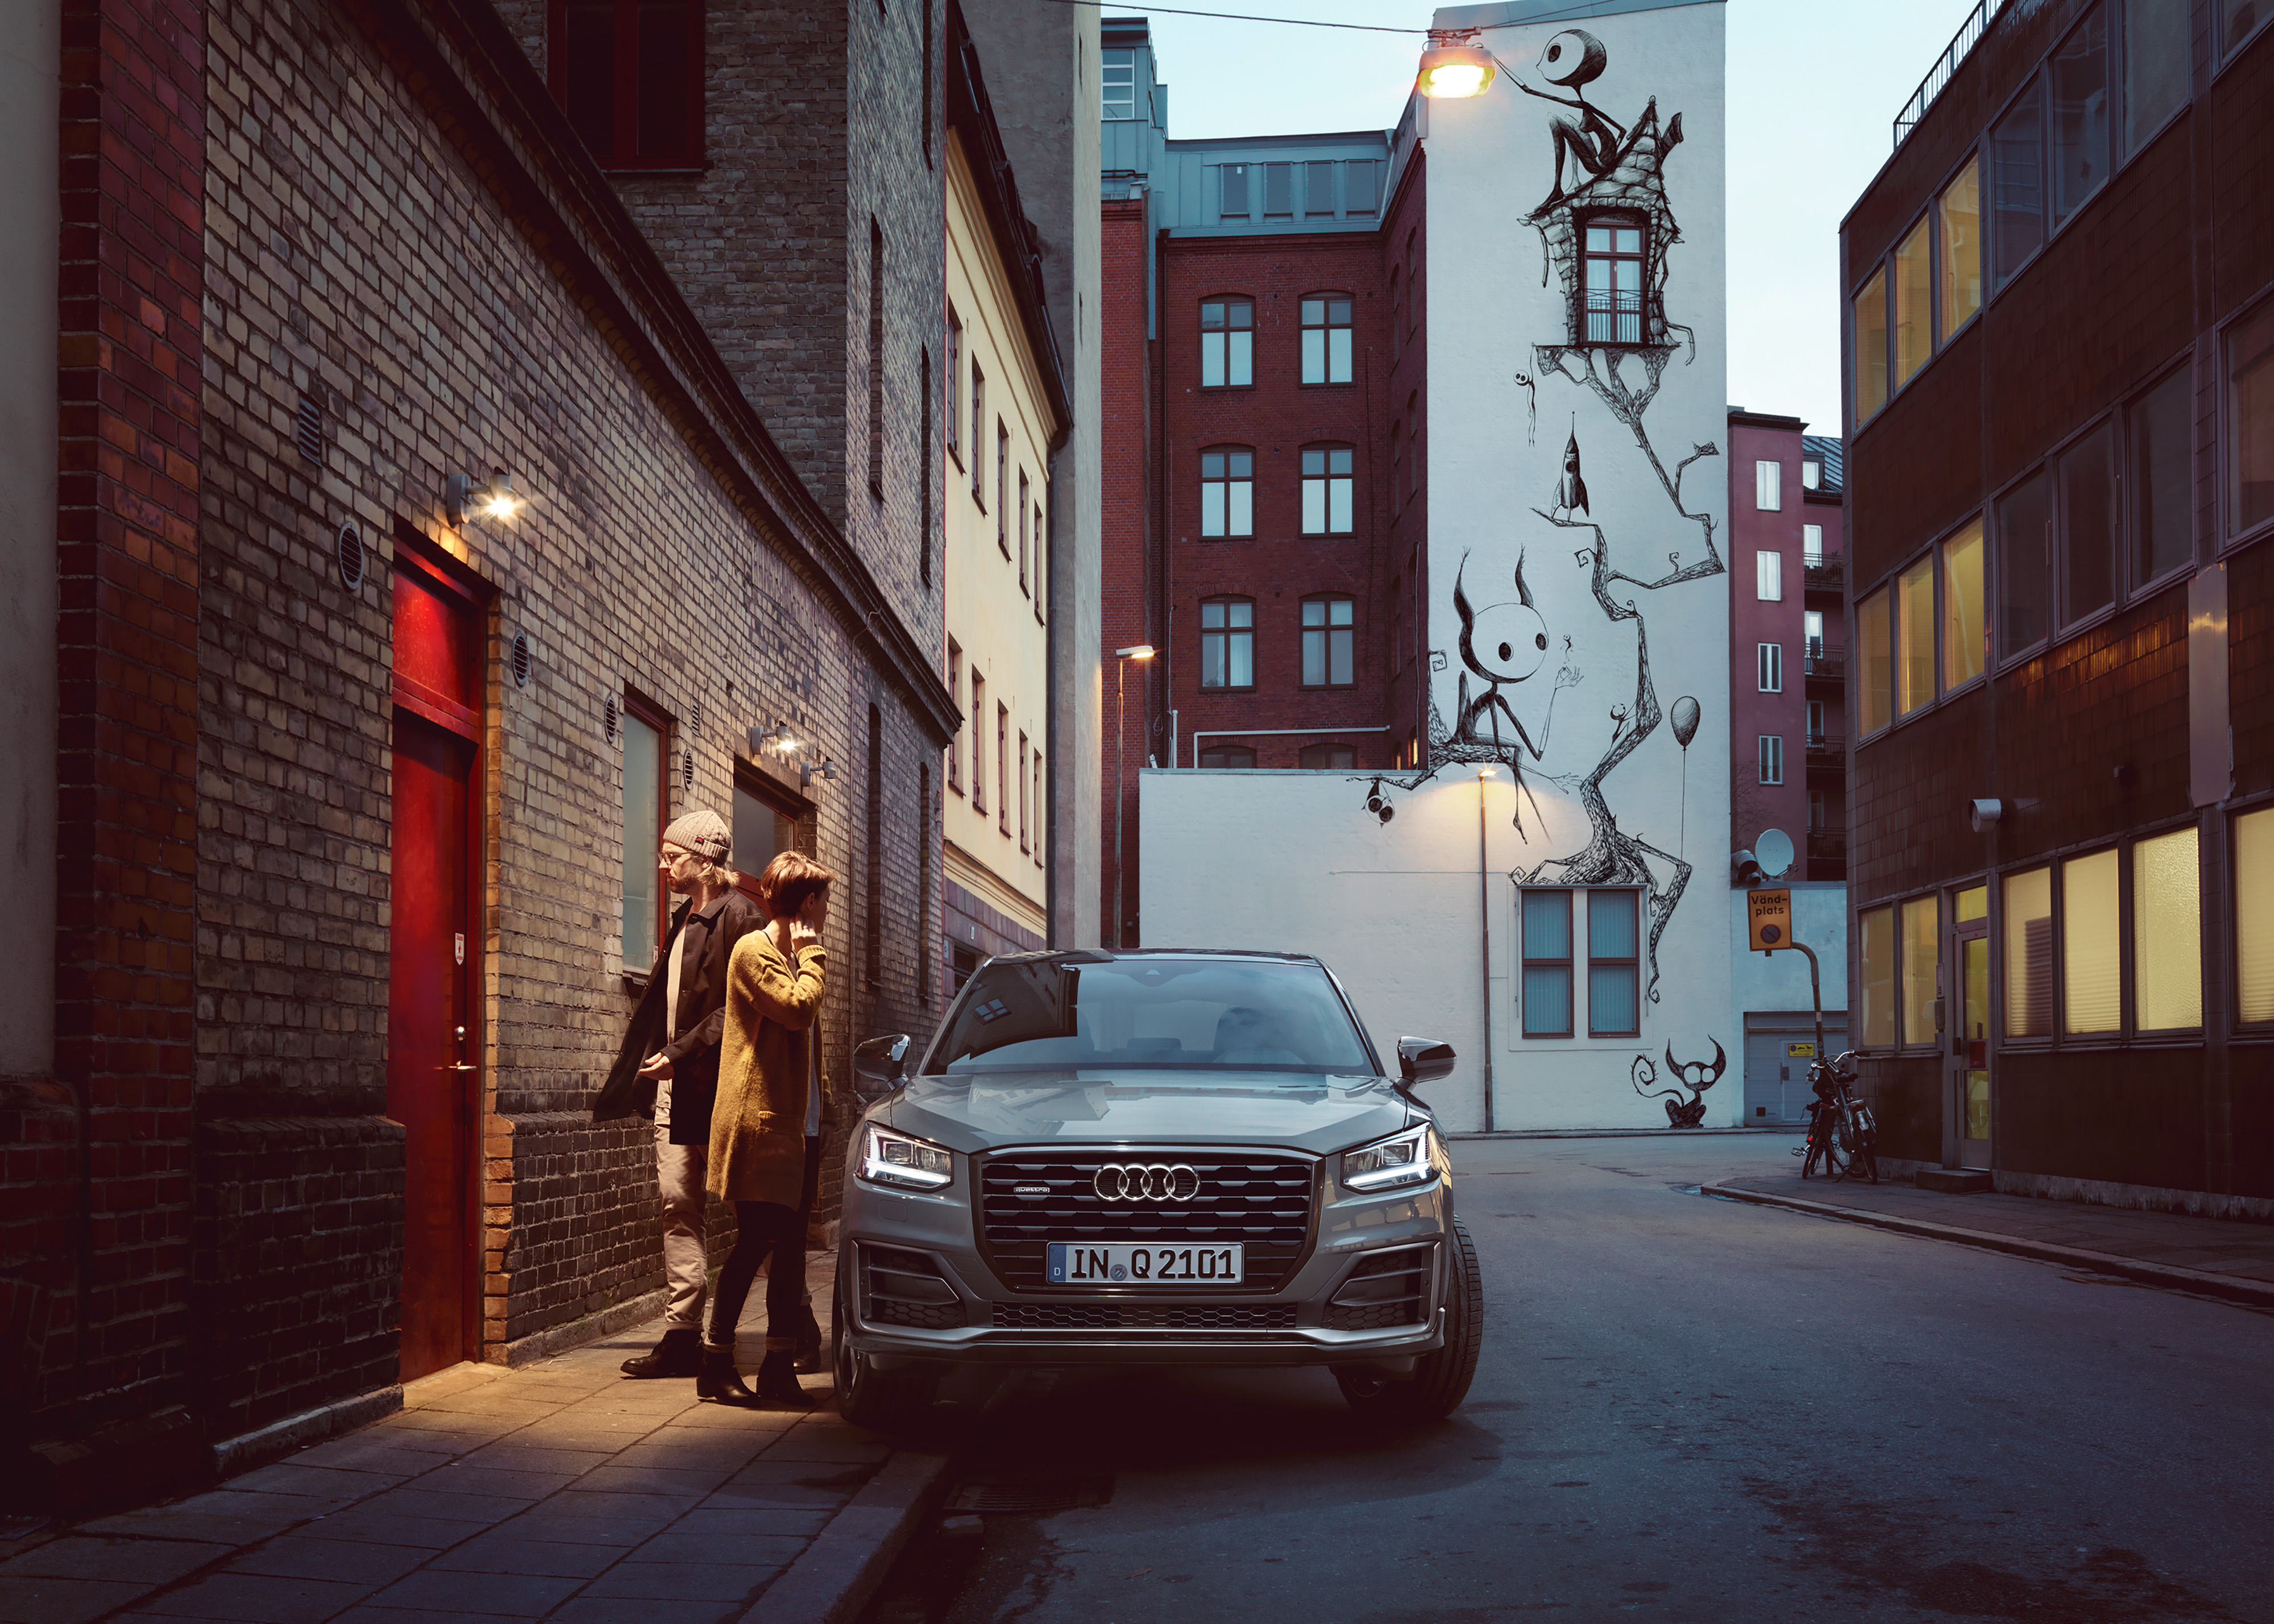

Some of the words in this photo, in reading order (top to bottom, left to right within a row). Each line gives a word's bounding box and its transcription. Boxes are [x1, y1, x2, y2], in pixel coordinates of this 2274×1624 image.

[1751, 894, 1788, 905] Vänd-
[1756, 906, 1784, 917] plats
[1071, 1248, 1109, 1278] IN
[1131, 1249, 1150, 1278] Q
[1157, 1249, 1236, 1279] 2101
